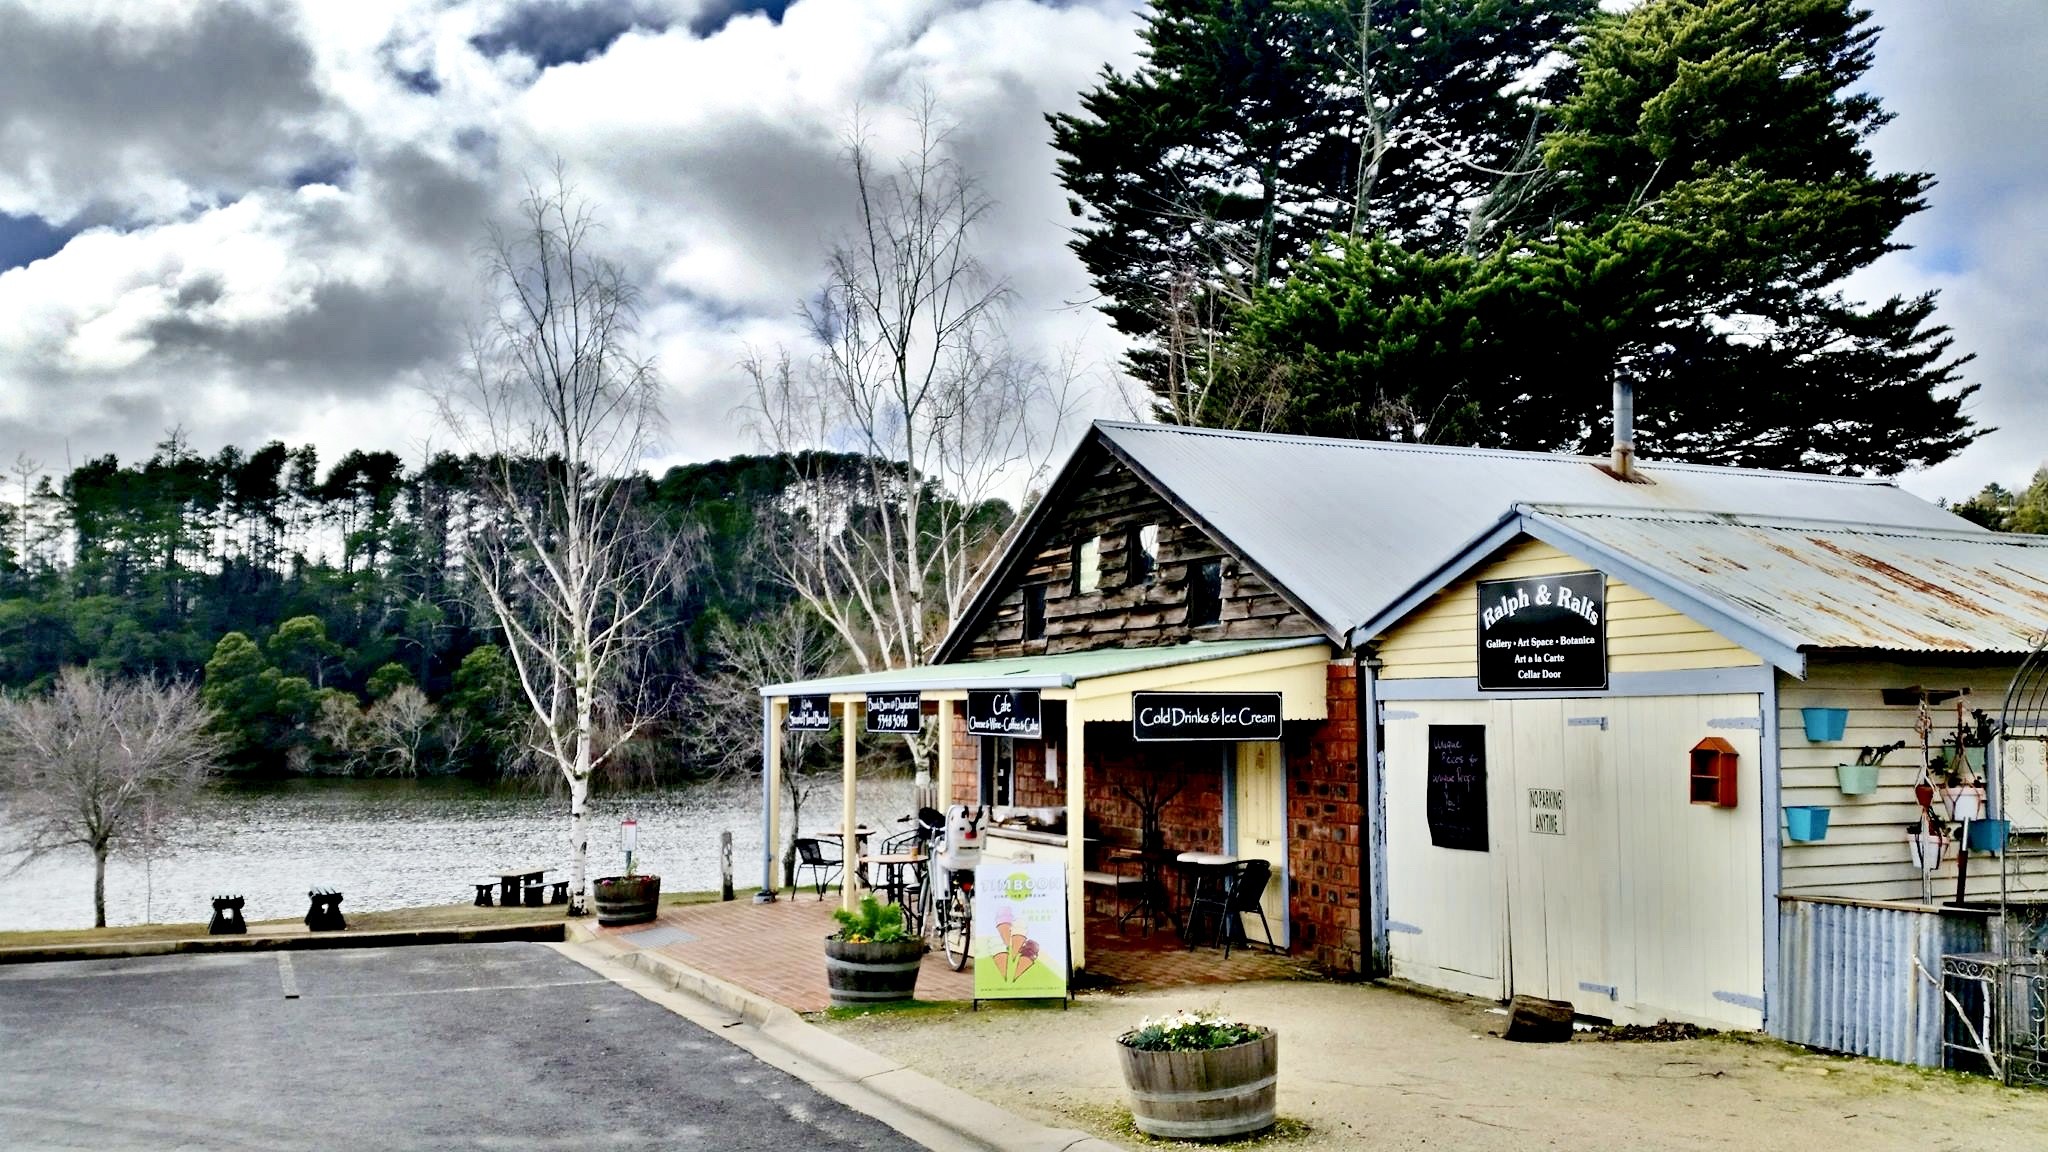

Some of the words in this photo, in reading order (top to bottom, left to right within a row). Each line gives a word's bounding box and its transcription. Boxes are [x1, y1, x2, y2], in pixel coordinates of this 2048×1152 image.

[1482, 588, 1530, 630] Ralph
[1535, 584, 1552, 606] &
[1557, 586, 1599, 626] Ralfs
[1486, 638, 1512, 649] Gallery
[1517, 638, 1530, 647] Art
[1531, 637, 1554, 648] Space
[1560, 635, 1596, 646] Botanica
[1514, 654, 1526, 664] Art
[1534, 653, 1542, 663] la
[1543, 653, 1565, 662] Carte
[1518, 669, 1541, 679] Cellar
[1542, 669, 1561, 679] Door
[992, 694, 1012, 715] Cafe
[1140, 707, 1171, 727] Cold
[1172, 707, 1210, 726] Drinks
[1210, 712, 1221, 723] &
[1221, 707, 1237, 725] Ice
[1238, 707, 1276, 726] Cream
[1529, 790, 1539, 808] NO
[1539, 790, 1562, 810] PARKING
[1535, 813, 1558, 833] ANYTIME
